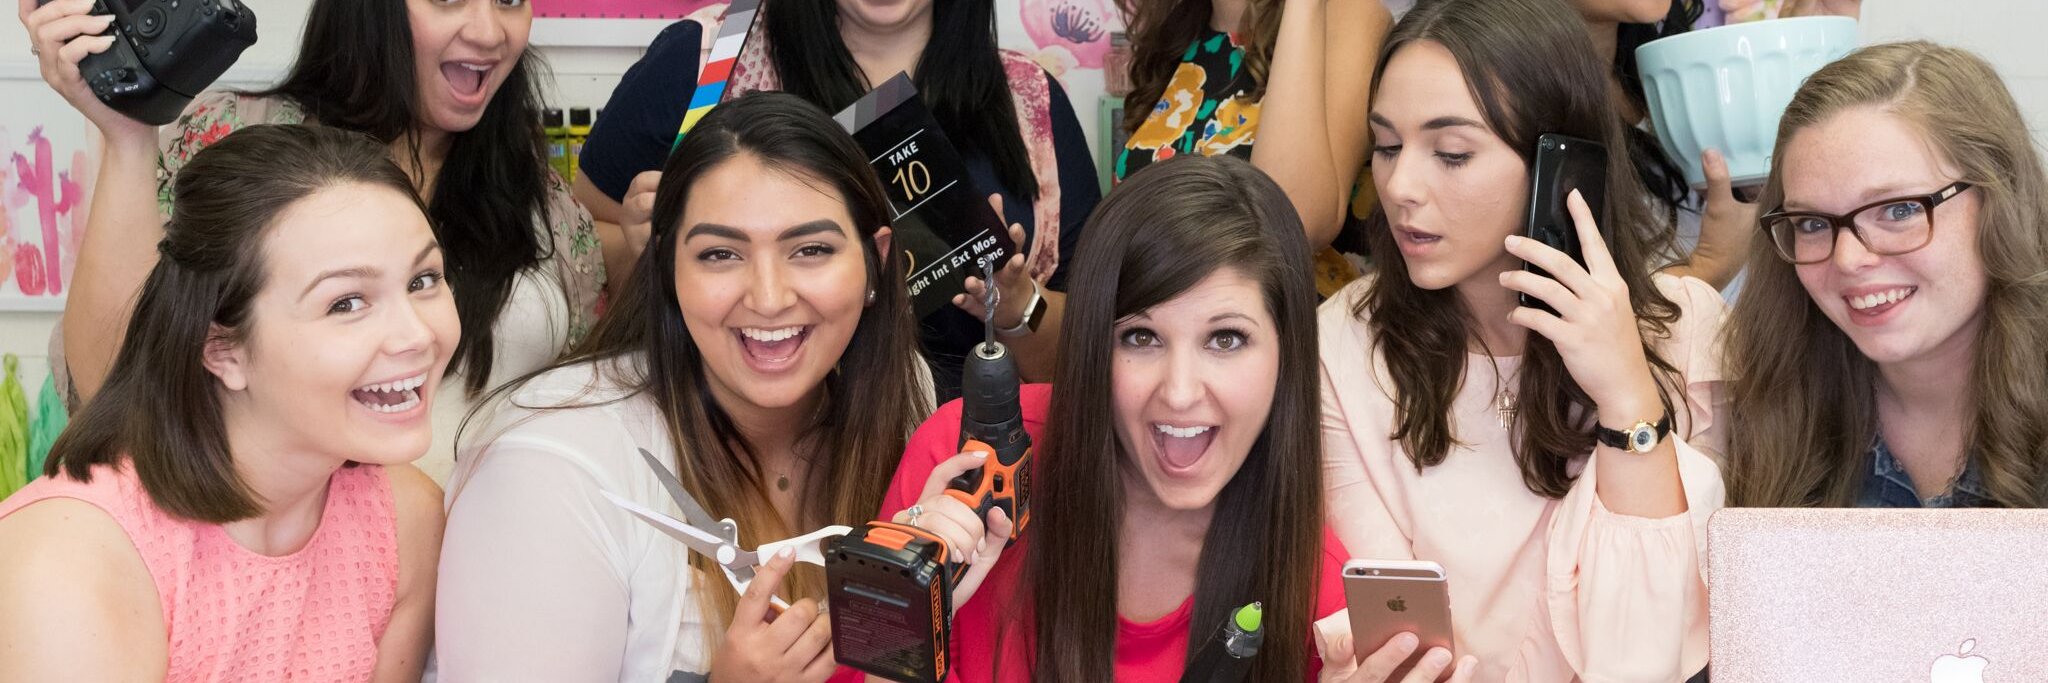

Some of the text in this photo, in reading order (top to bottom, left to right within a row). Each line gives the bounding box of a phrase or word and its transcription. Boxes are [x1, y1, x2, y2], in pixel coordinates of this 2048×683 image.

[889, 141, 919, 166] TAKE
[891, 160, 931, 201] 10
[908, 276, 930, 297] ight
[931, 263, 950, 280] Int
[950, 250, 971, 268] Ext
[972, 235, 997, 255] Mos
[976, 247, 1004, 268] Snc
